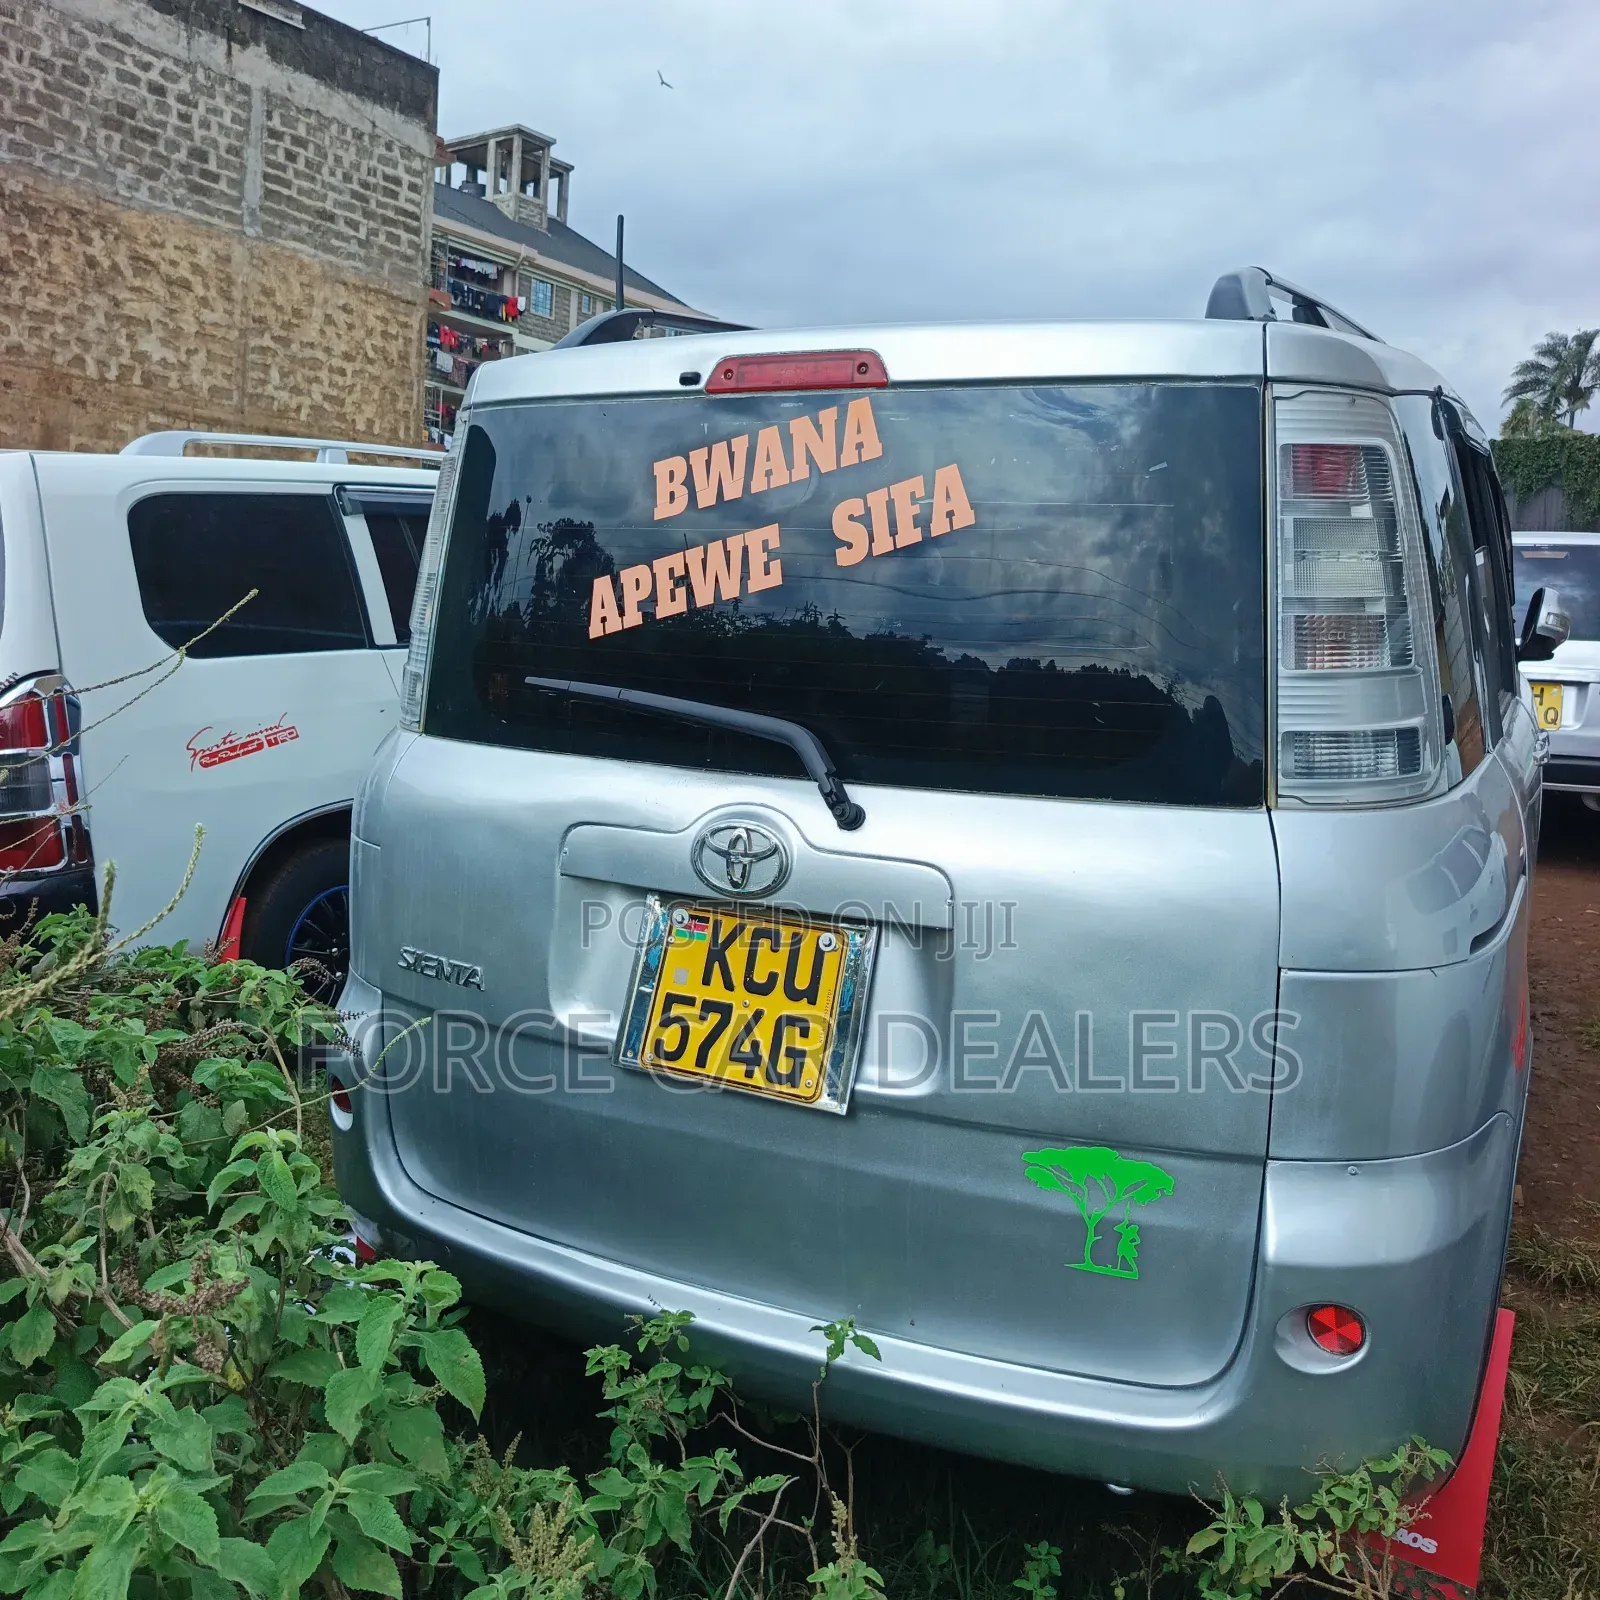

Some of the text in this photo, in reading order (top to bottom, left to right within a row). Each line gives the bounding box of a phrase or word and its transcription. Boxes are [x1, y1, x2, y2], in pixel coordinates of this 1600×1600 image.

[653, 396, 884, 521] BWANA
[589, 463, 976, 640] APEWE SIFA
[397, 945, 485, 992] SIENTA
[700, 918, 826, 1006] KCU
[653, 991, 812, 1089] 574G
